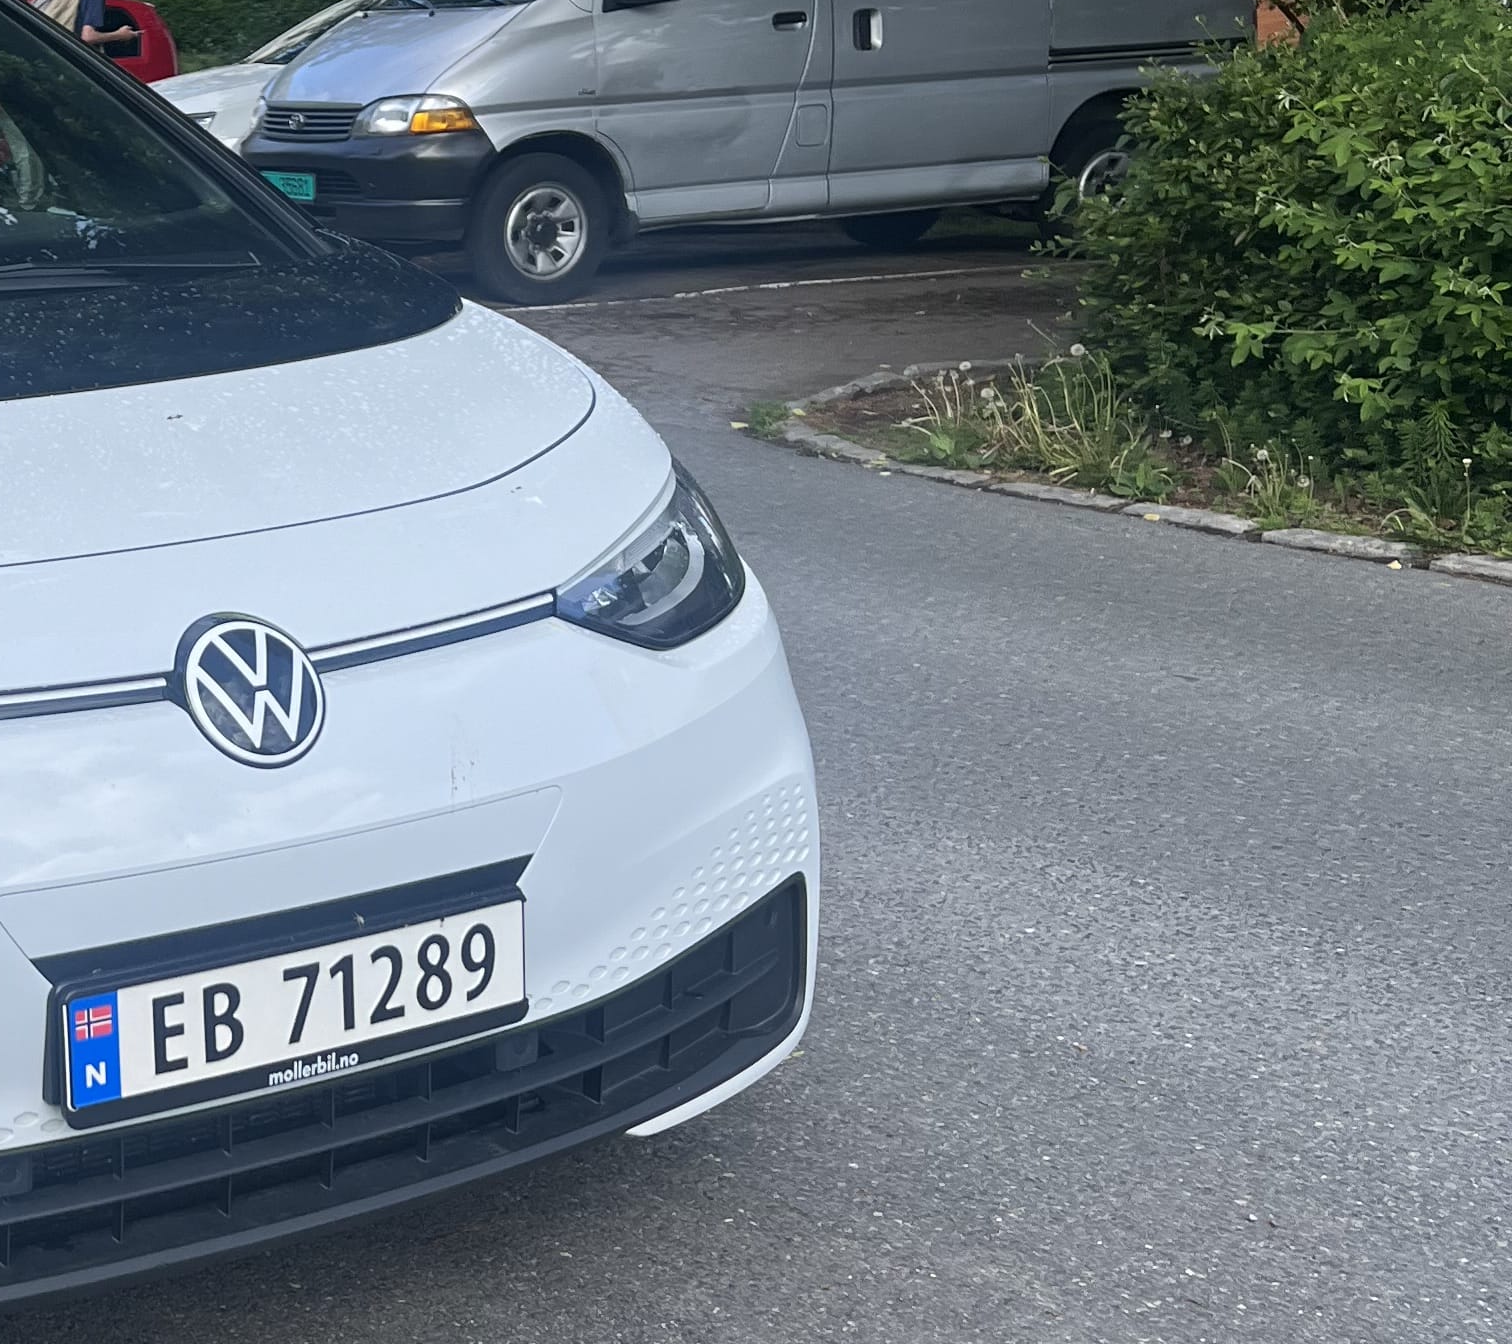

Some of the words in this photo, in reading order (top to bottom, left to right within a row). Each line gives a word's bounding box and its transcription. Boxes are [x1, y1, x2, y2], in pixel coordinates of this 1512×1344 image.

[151, 982, 244, 1075] EB
[282, 922, 496, 1045] 71289
[85, 1061, 107, 1088] N
